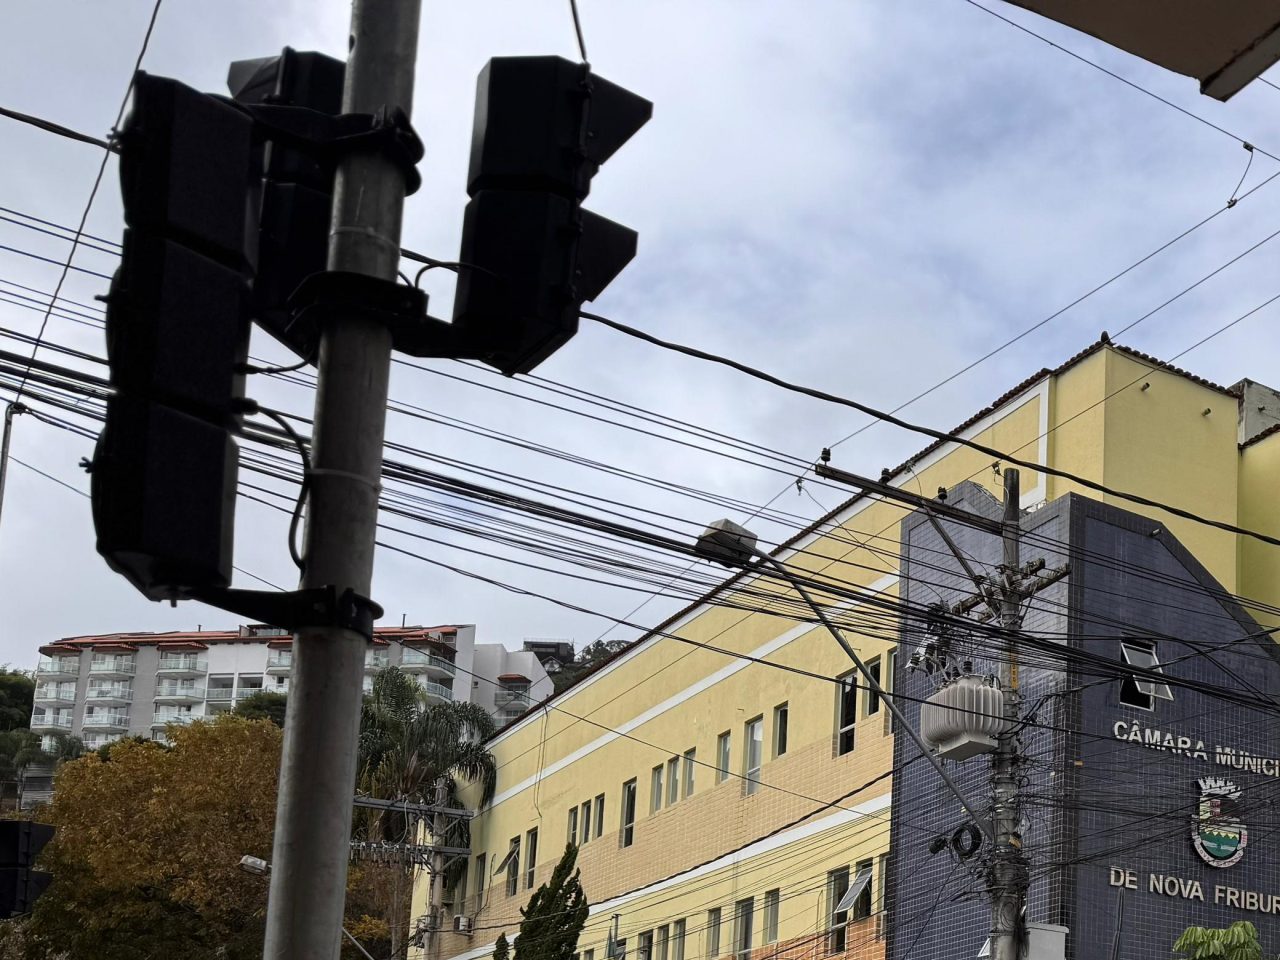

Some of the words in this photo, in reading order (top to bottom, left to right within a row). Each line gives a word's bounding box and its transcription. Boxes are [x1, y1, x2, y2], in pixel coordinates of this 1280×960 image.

[1113, 719, 1208, 761] CÂMARA
[1109, 865, 1138, 890] DE
[1149, 873, 1205, 902] NOVA
